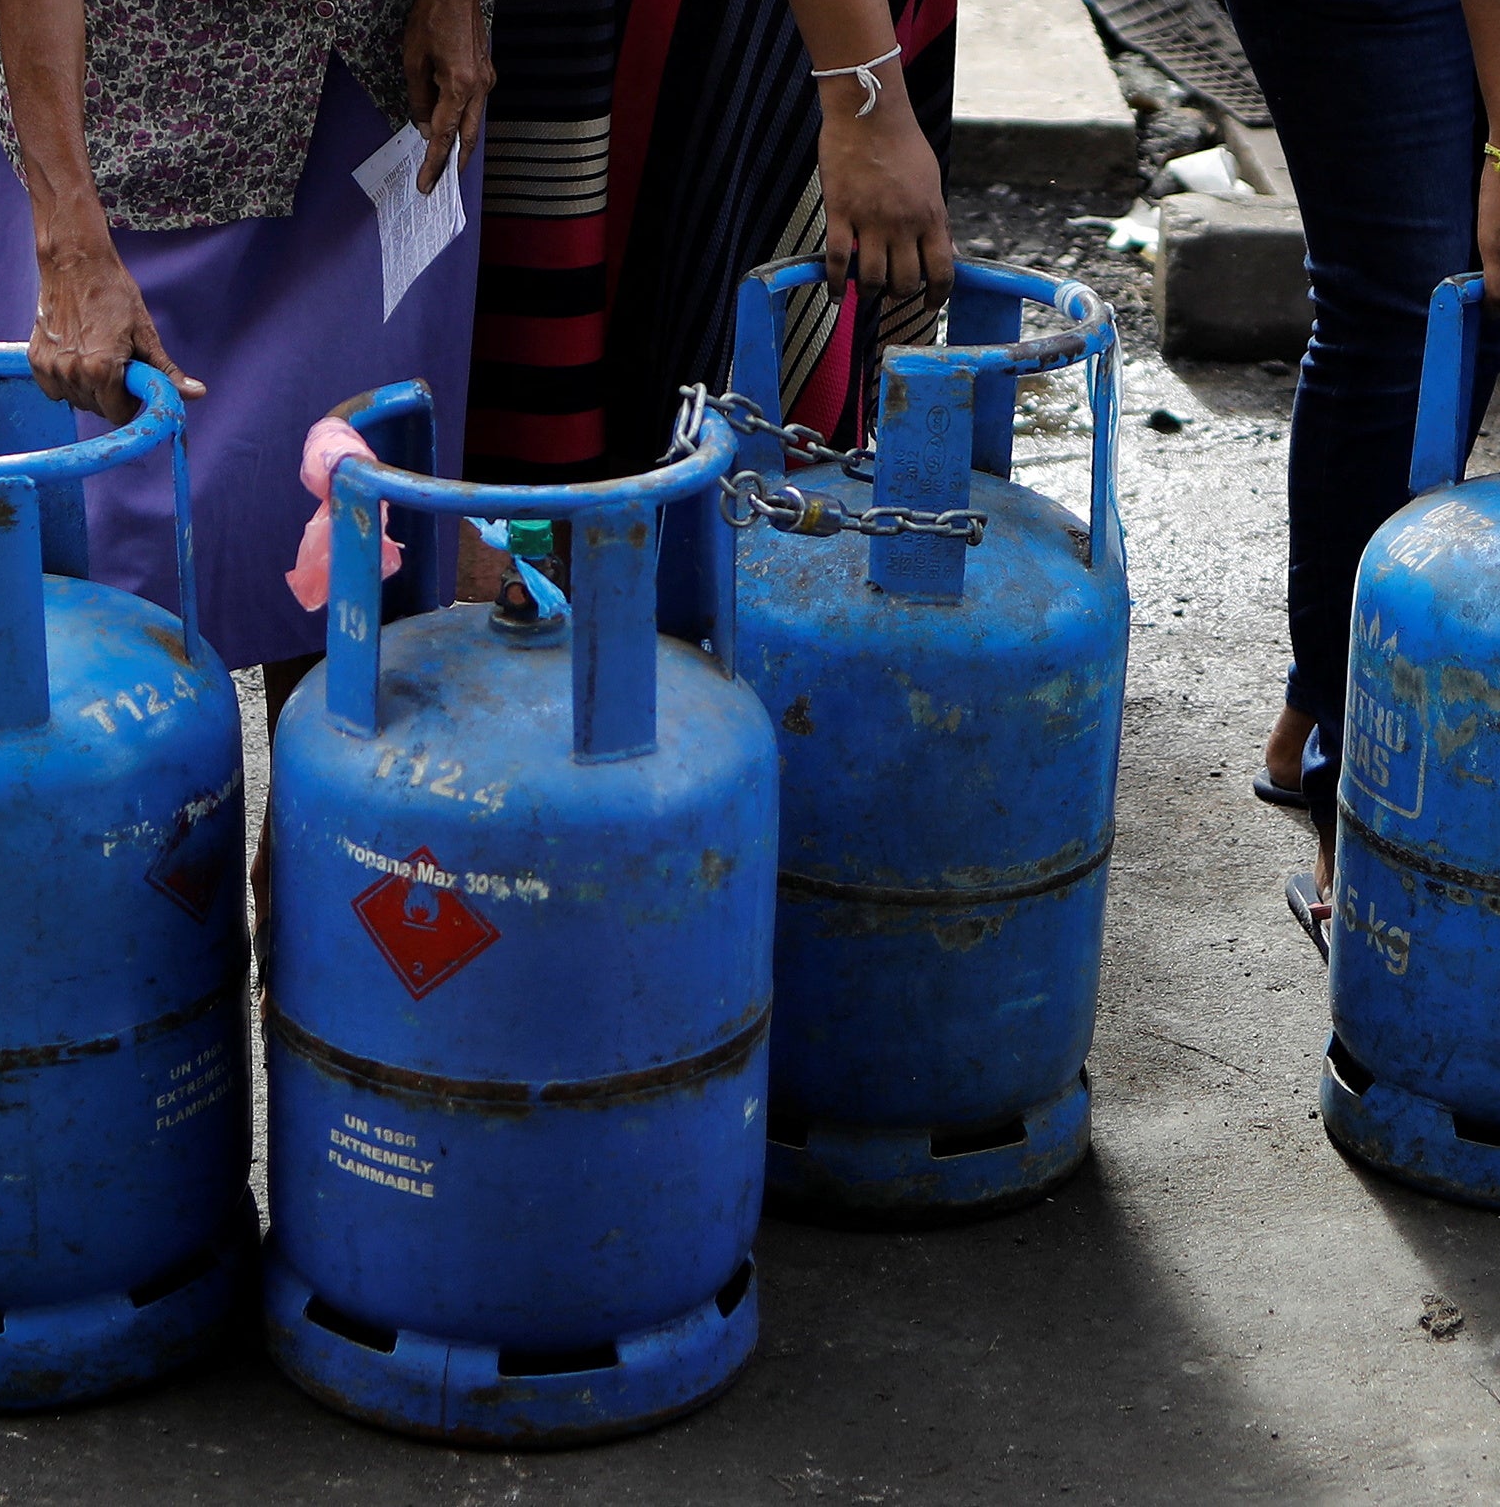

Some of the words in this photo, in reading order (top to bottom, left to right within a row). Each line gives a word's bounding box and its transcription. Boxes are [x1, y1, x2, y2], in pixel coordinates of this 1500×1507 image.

[336, 598, 368, 642] 19
[79, 671, 198, 734] T12.4
[374, 744, 510, 815] T12.4
[417, 860, 460, 890] Max
[464, 871, 512, 902] 30%
[1366, 901, 1411, 976] kg
[412, 961, 424, 977] 2
[170, 1059, 192, 1081] UN
[344, 1113, 369, 1135] UN
[328, 1148, 435, 1199] FLAMMABLE
[330, 1128, 435, 1175] EXTREMELY
